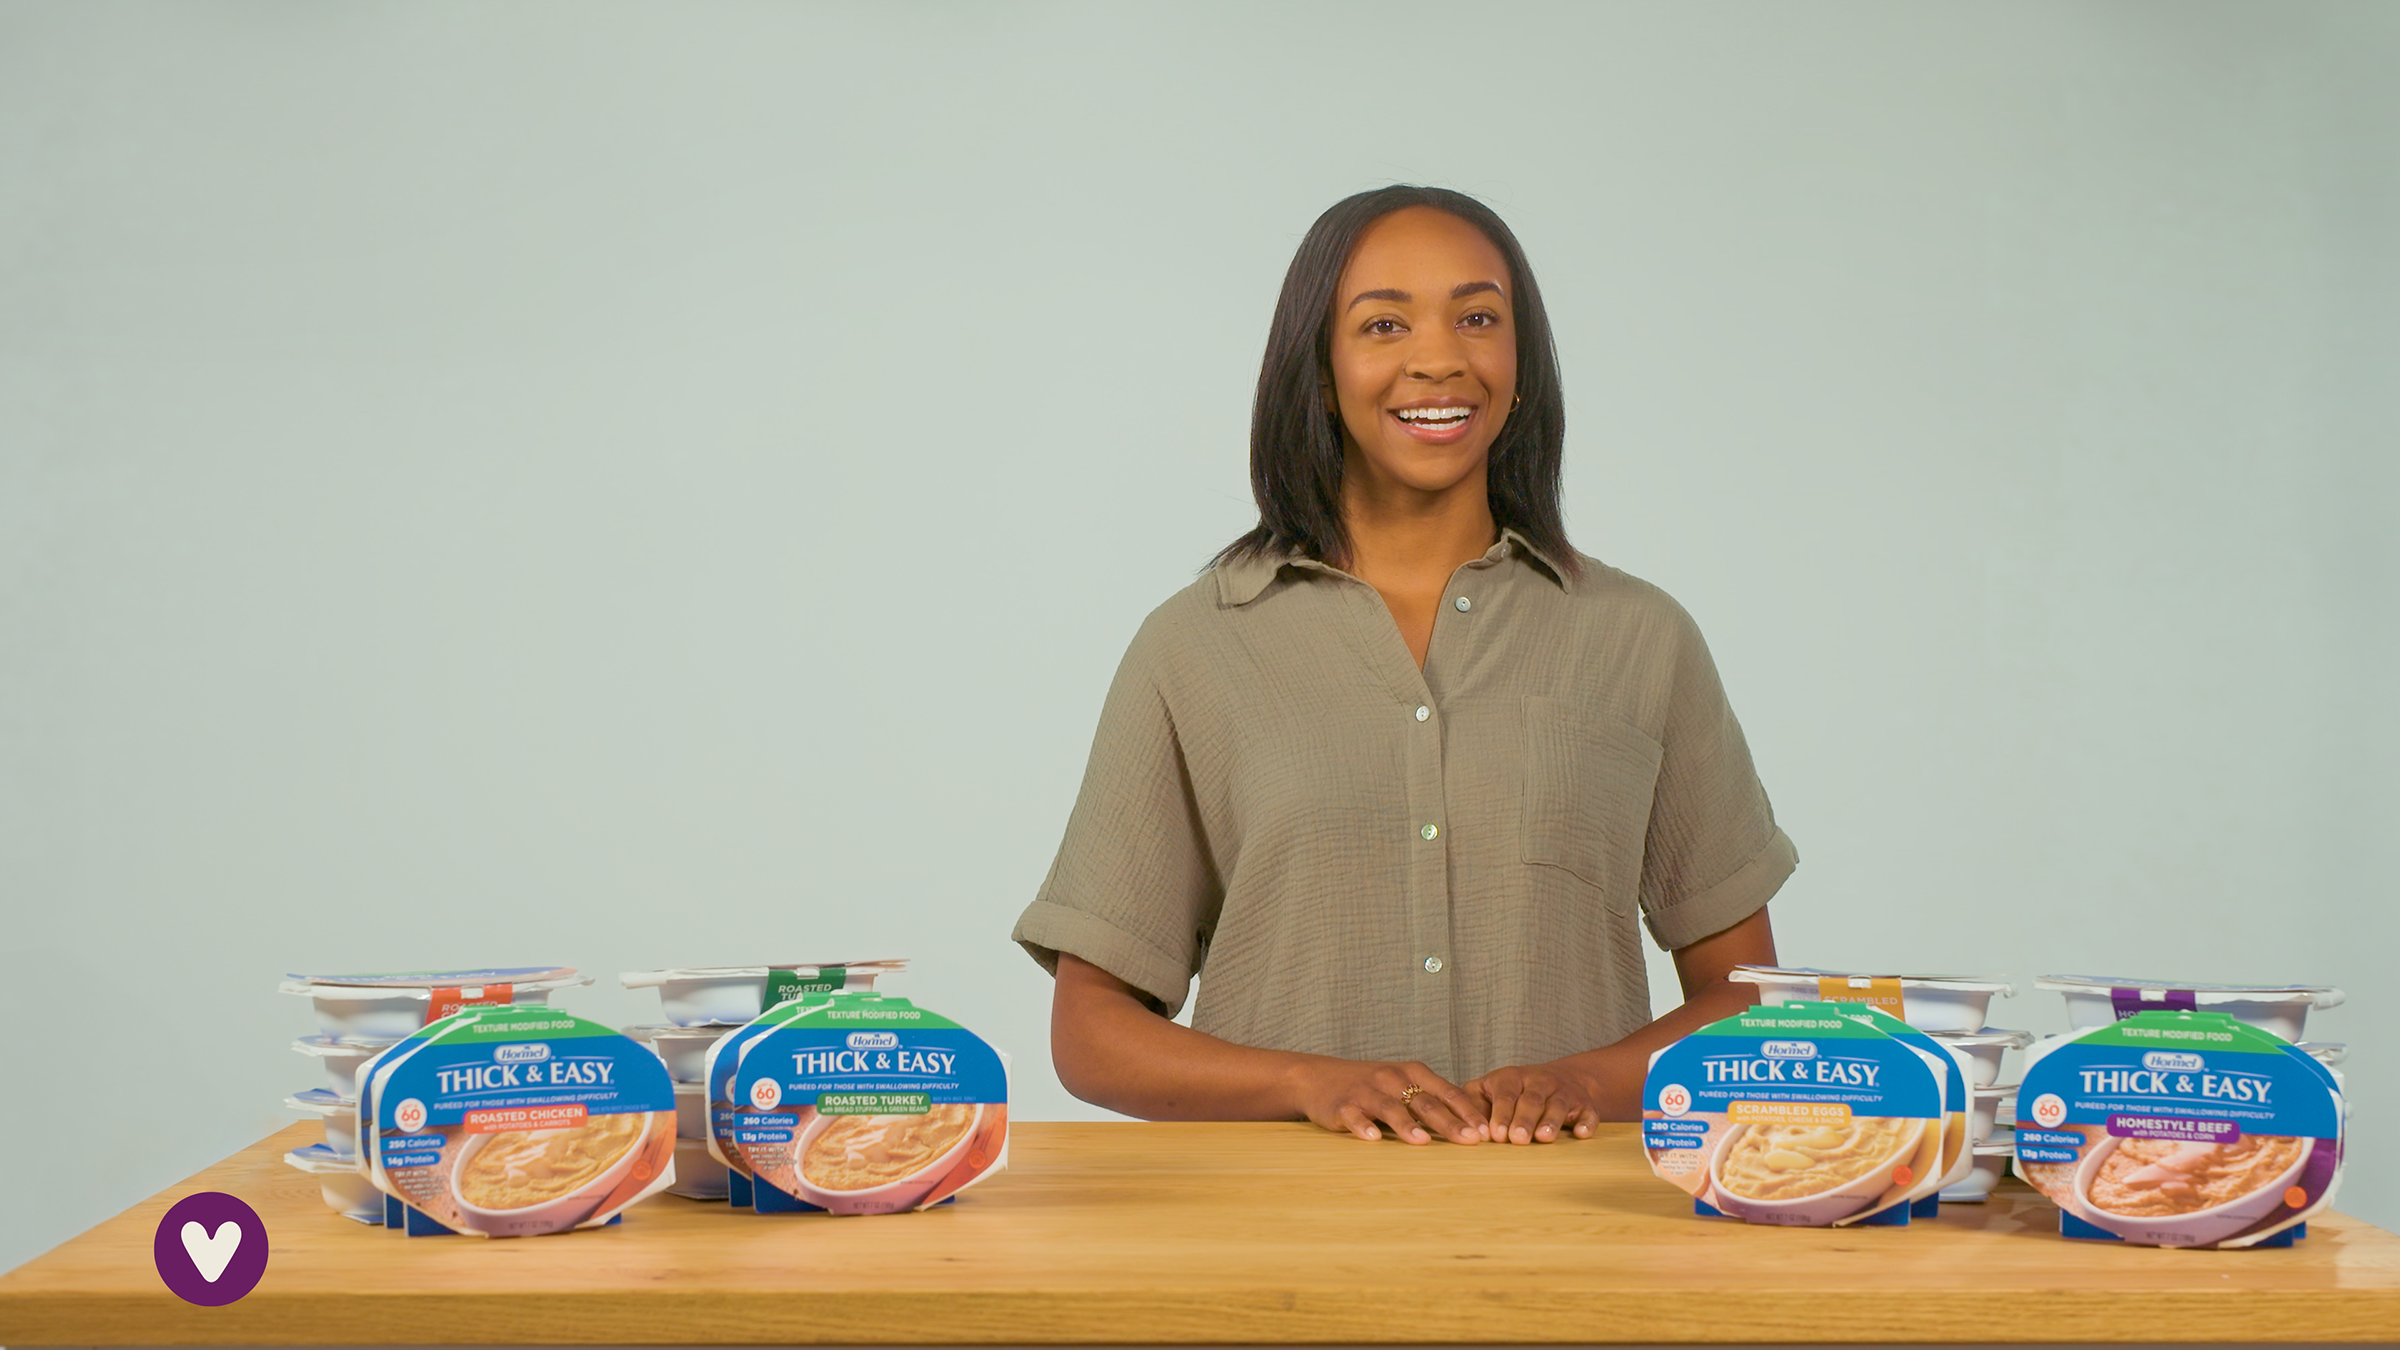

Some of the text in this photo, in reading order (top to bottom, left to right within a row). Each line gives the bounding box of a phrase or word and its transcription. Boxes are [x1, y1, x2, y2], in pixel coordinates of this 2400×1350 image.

[778, 984, 832, 993] ROASTED
[827, 1011, 920, 1019] TEXTURE MODIFIED FOOD
[473, 1020, 575, 1033] TEXTURE MODIFIED FOOD
[1740, 1019, 1842, 1028] TEXTURE MODIFIED FOOD
[2122, 1028, 2232, 1041] TEXTURE MODIFIED FOOD
[853, 1036, 892, 1046] Hormel
[502, 1047, 544, 1059] Hormel
[1768, 1045, 1810, 1055] Hormel
[792, 1051, 955, 1074] THICK & EASY
[2151, 1056, 2197, 1068] Hormel
[436, 1062, 614, 1093] THICK & EASY
[1702, 1060, 1879, 1086] THICK & EASY
[2079, 1071, 2272, 1103] THICK & EASY
[482, 1099, 505, 1107] THOSE
[527, 1095, 575, 1104] SWALLOWING
[577, 1092, 618, 1101] DIFFICULTY
[756, 1088, 775, 1100] 60
[1665, 1094, 1684, 1105] 60
[825, 1096, 877, 1106] ROASTED
[880, 1096, 924, 1104] TURKEY
[401, 1109, 420, 1121] 60
[471, 1111, 527, 1124] ROASTED
[530, 1108, 582, 1120] CHICKEN
[1736, 1105, 1844, 1116] SCRAMBLED EGGS
[2039, 1105, 2059, 1116] 60
[2126, 1104, 2151, 1112] THOSE
[2175, 1107, 2229, 1117] SWALLOWING
[2229, 1110, 2275, 1120] DIFFICULTY
[499, 1121, 532, 1129] POTATOES
[540, 1119, 571, 1127] CARROTS
[743, 1117, 793, 1125] 260 Calories
[2116, 1117, 2232, 1133] HOMESTYLE BEEF
[1670, 1123, 1704, 1131] Calories
[742, 1132, 787, 1141] 13g Protein
[2043, 1134, 2079, 1144] Calories
[2149, 1130, 2187, 1139] POTATOES
[407, 1138, 441, 1148] Calories
[1650, 1138, 1665, 1147] 14g
[405, 1154, 434, 1164] Protein
[2039, 1150, 2071, 1160] Protein
